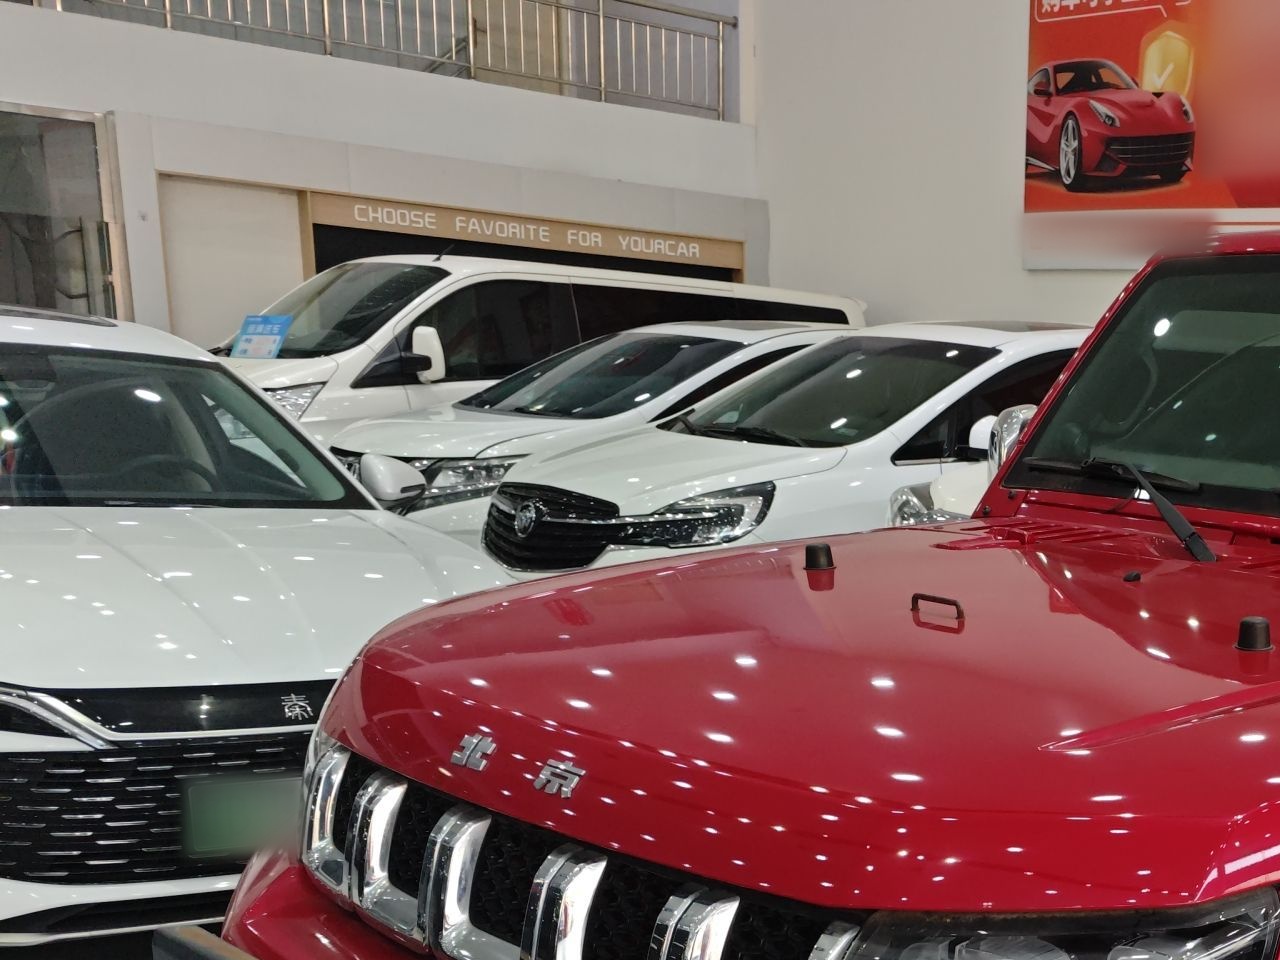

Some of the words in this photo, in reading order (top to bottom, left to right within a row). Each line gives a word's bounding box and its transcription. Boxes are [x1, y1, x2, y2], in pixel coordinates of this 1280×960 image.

[354, 204, 437, 229] CHOOSE
[455, 216, 550, 242] FAVORITE
[567, 229, 602, 248] FOR
[619, 235, 700, 258] YOURCAR
[280, 693, 314, 720] 秦
